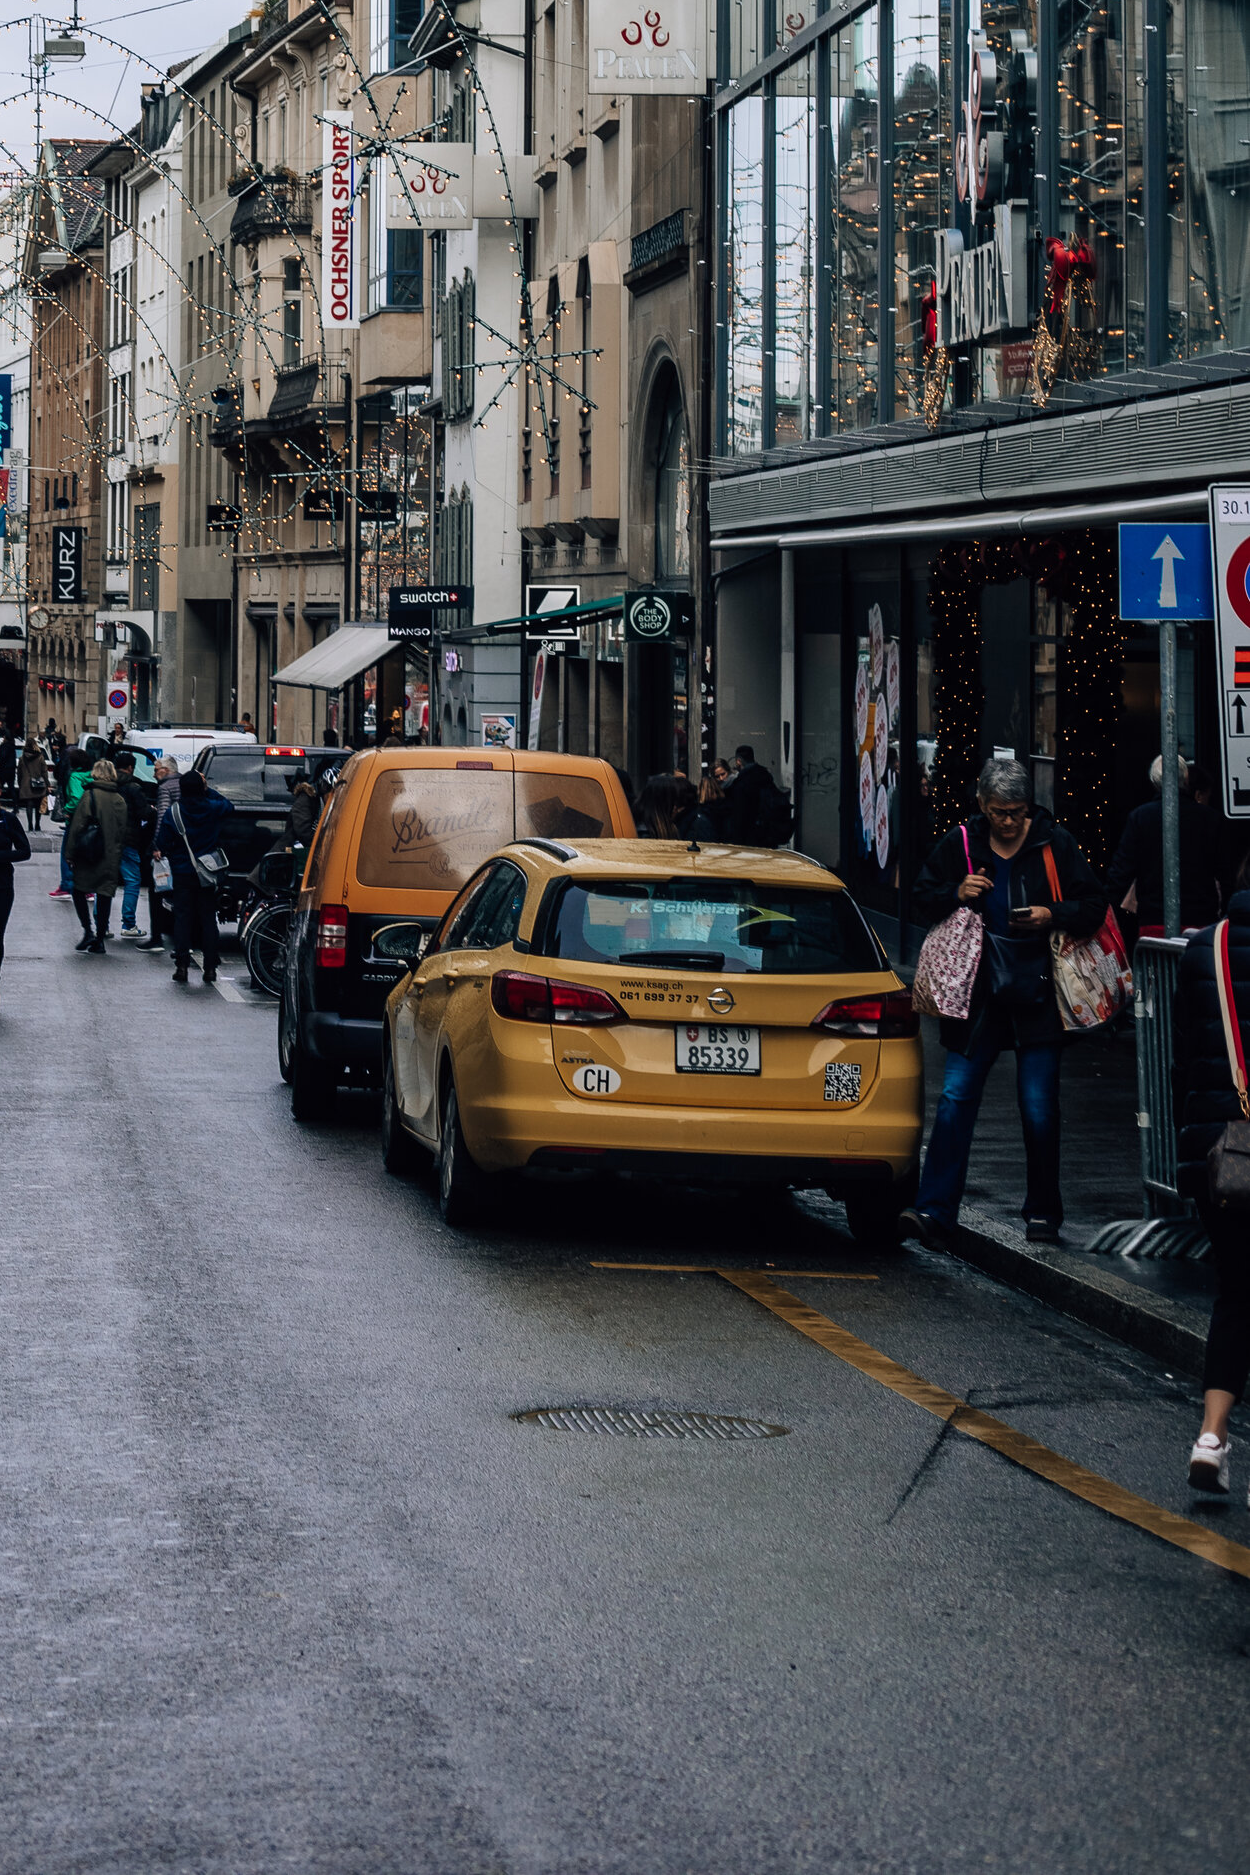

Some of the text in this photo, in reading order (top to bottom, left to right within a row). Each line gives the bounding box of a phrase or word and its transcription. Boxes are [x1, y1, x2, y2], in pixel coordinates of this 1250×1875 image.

[594, 47, 701, 80] PFAUEN
[330, 122, 350, 321] OCHSNER SPORT
[934, 198, 1029, 349] PFAUEN
[7, 470, 18, 513] exedra
[58, 530, 76, 600] KURZ
[400, 590, 450, 604] swatch
[638, 614, 663, 623] BODY
[639, 622, 662, 630] SHOP
[389, 627, 431, 636] MANGO
[629, 901, 745, 916] K. Schweizer
[361, 974, 398, 982] CADDY
[620, 979, 684, 991] www.ksag.ch
[619, 991, 699, 1004] 061 699 37 37
[707, 1027, 729, 1044] BS
[687, 1045, 750, 1068] 85339
[583, 1068, 610, 1093] CH
